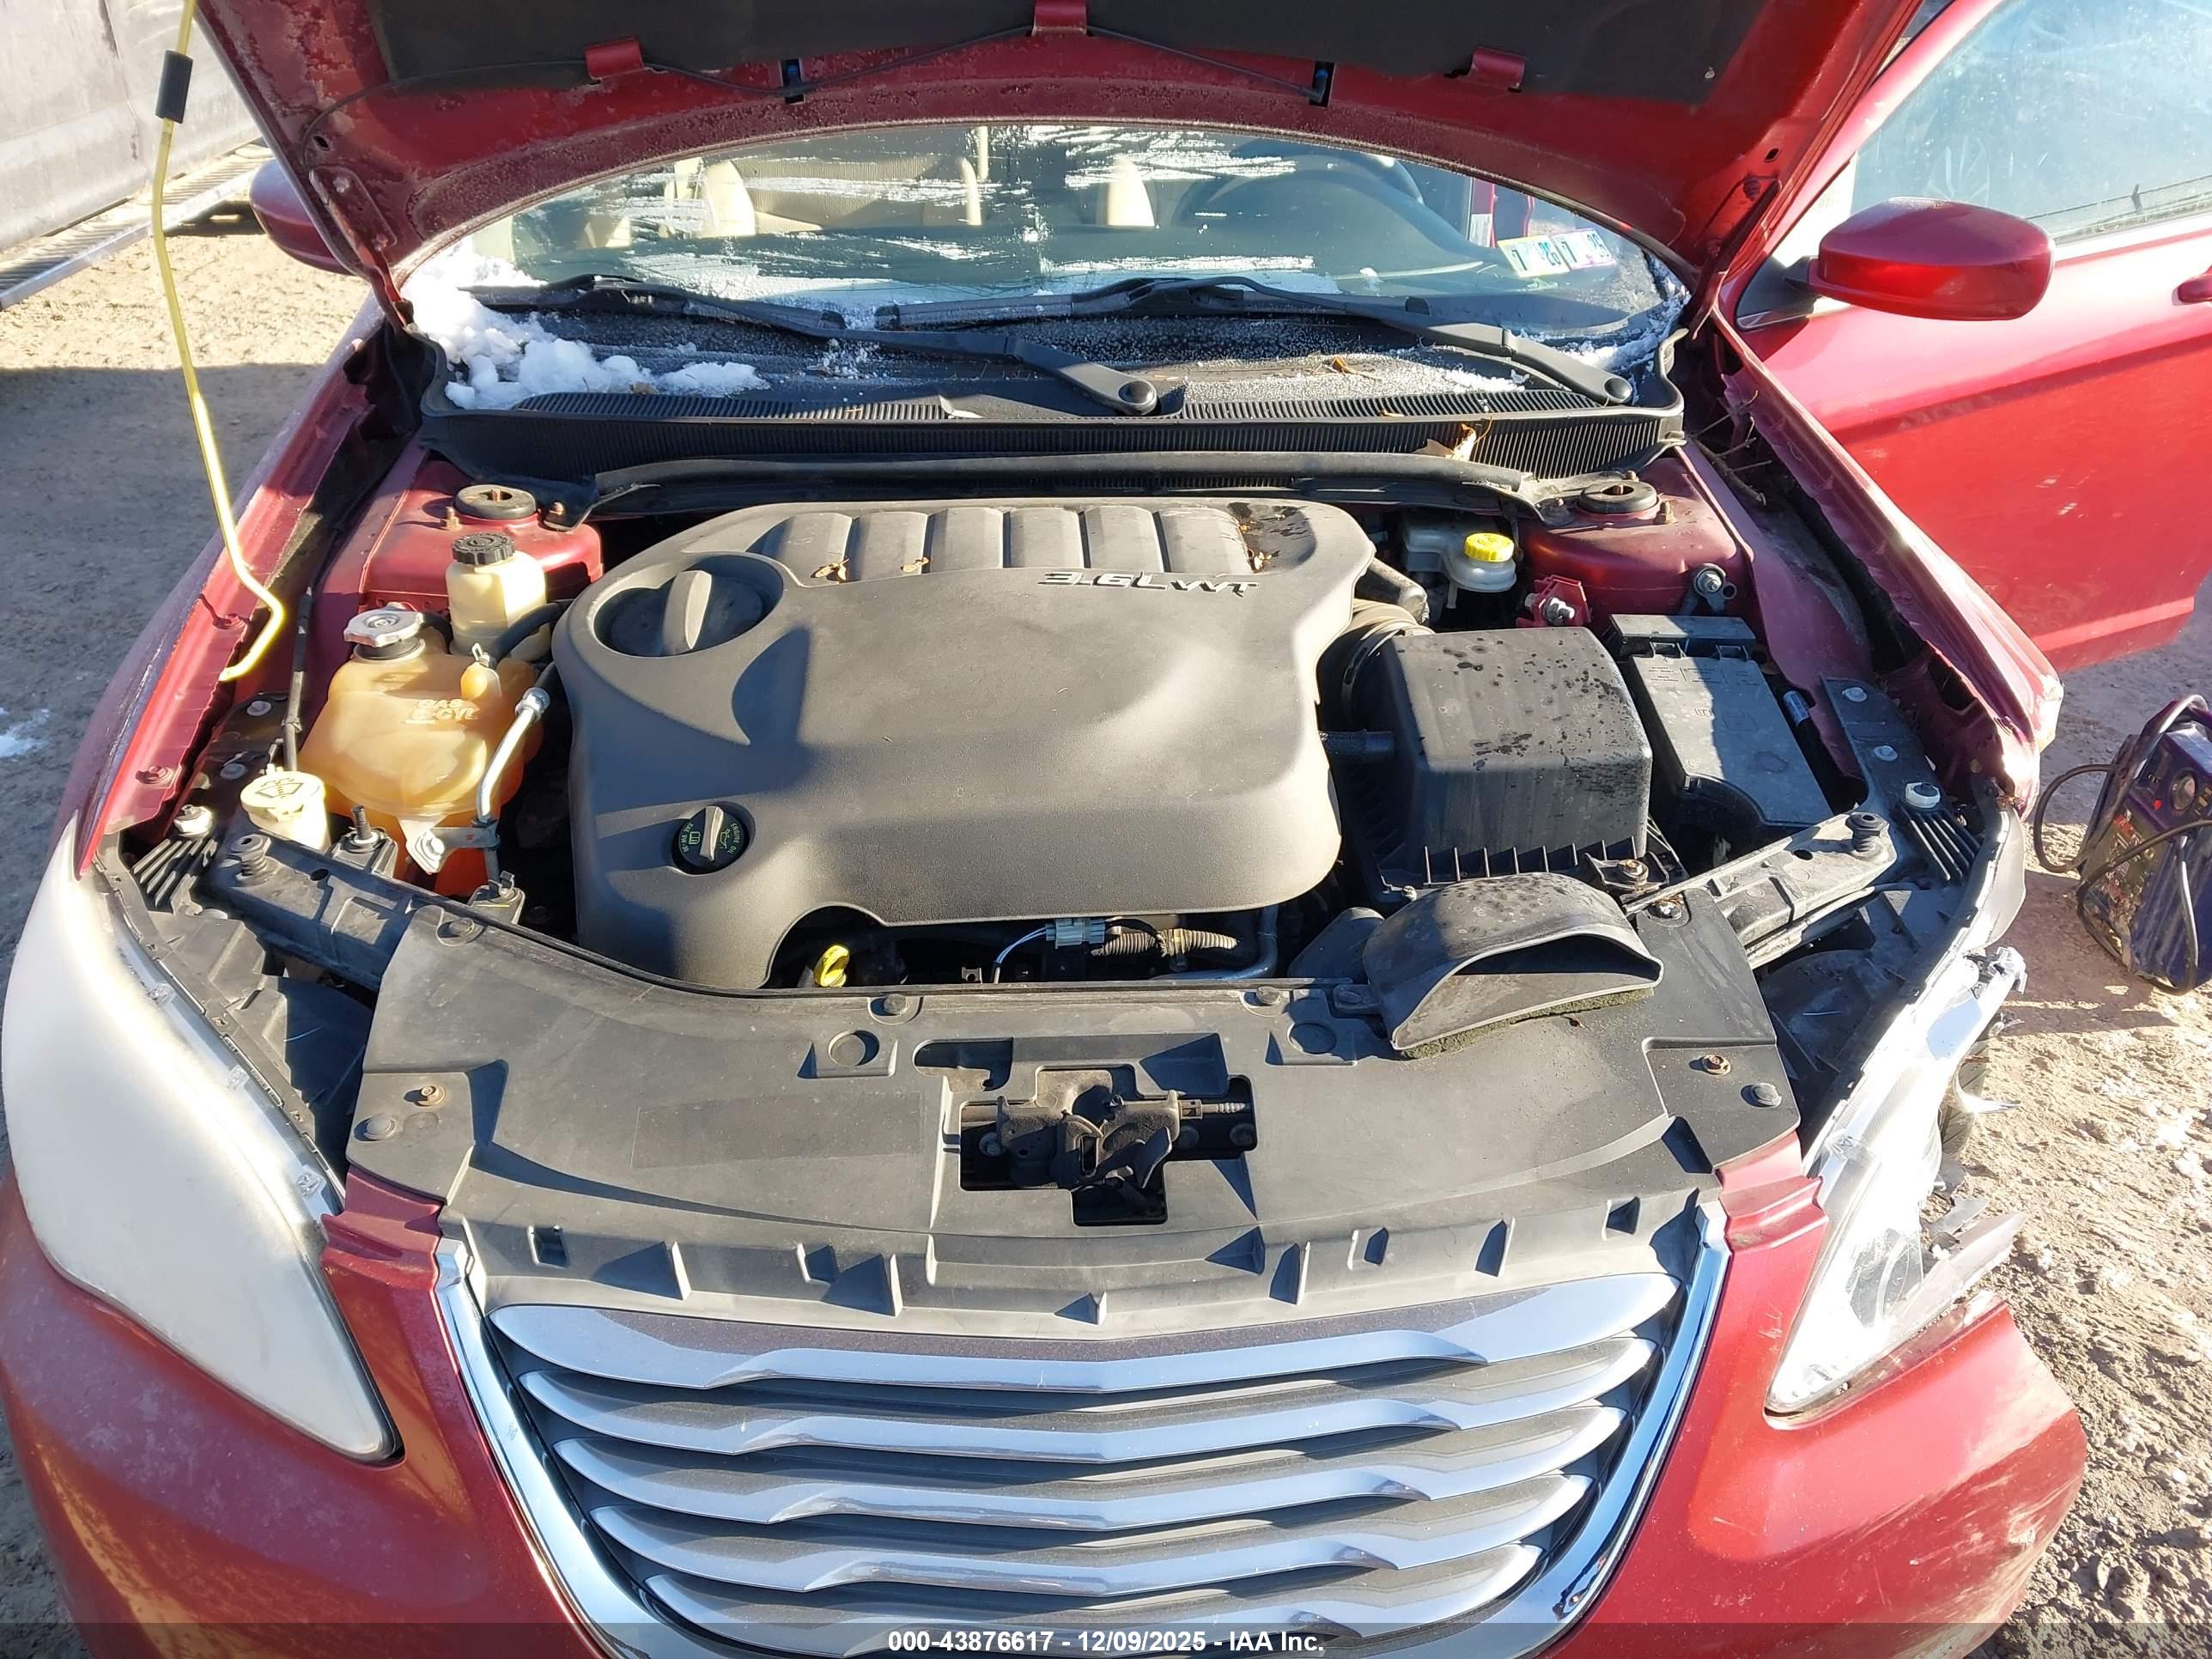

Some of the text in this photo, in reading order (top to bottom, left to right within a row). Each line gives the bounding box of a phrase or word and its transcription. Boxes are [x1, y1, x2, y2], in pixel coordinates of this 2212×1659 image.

[1037, 571, 1166, 591] 3.6L
[726, 823, 741, 854] ENGINE OIL
